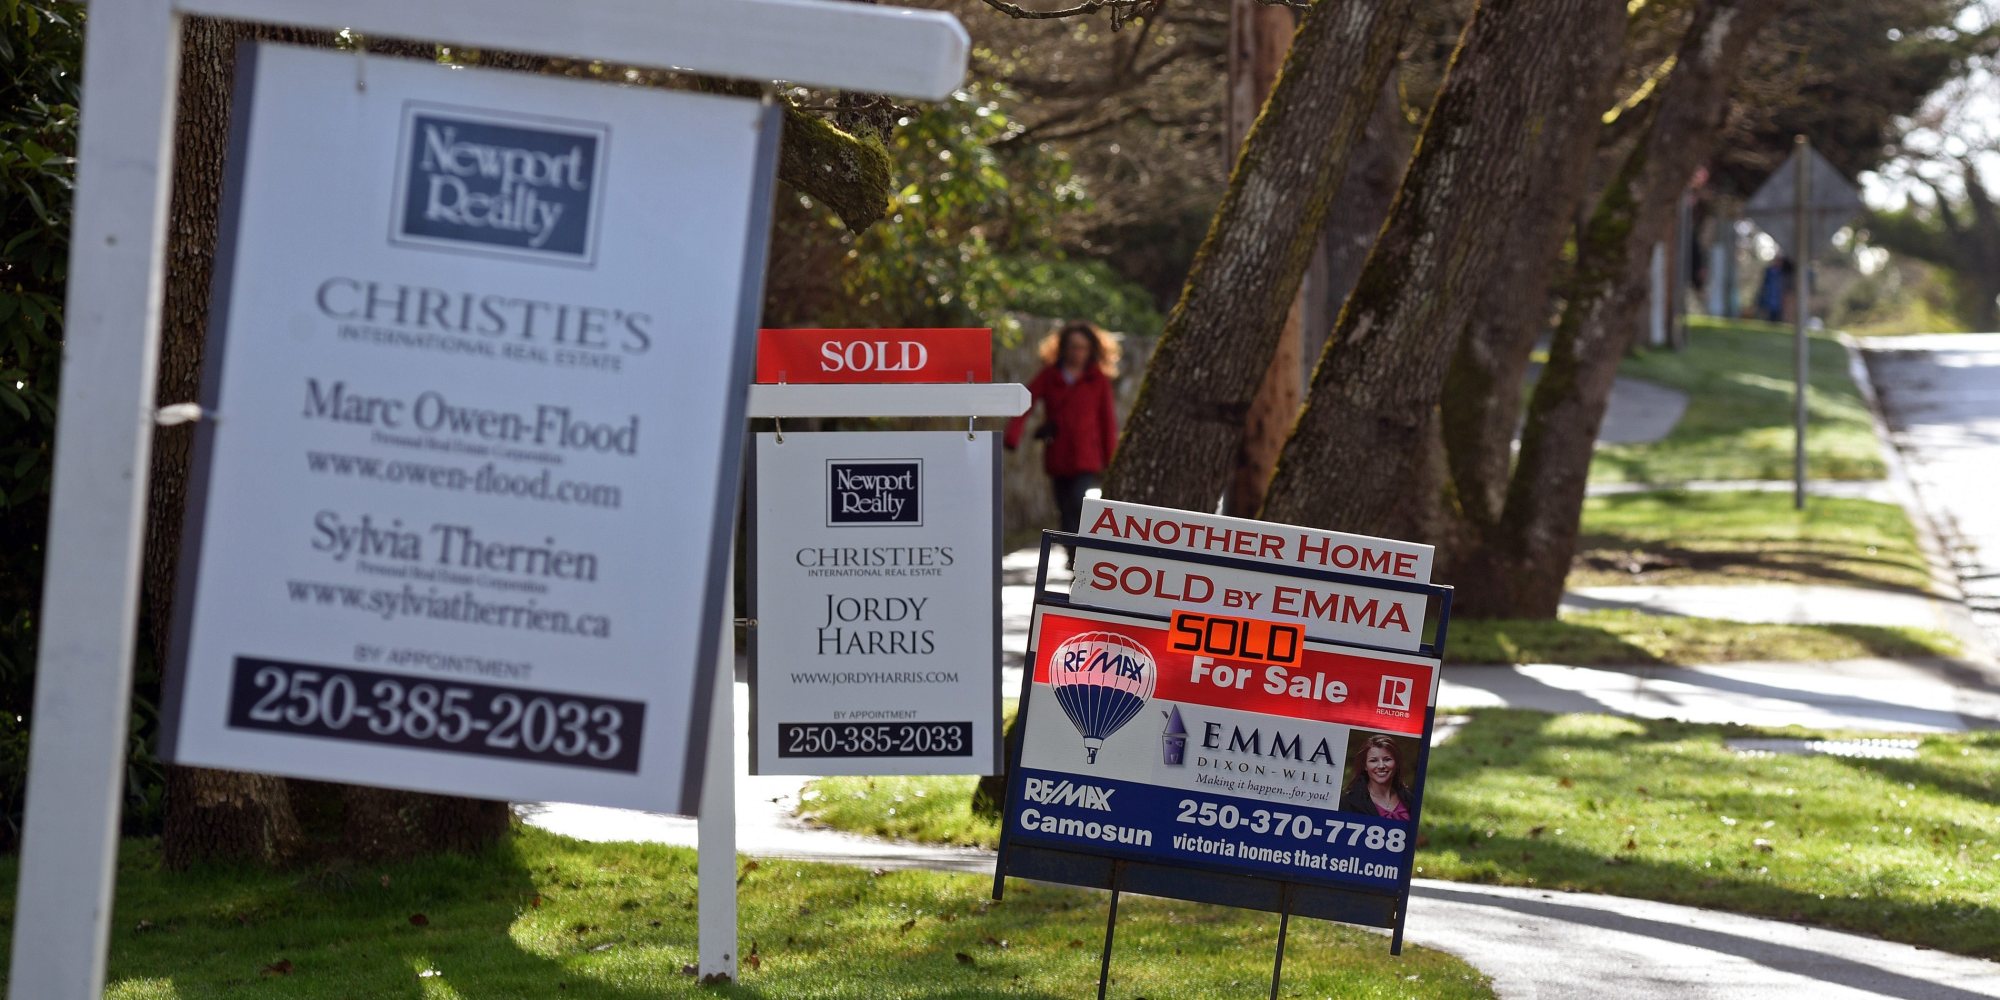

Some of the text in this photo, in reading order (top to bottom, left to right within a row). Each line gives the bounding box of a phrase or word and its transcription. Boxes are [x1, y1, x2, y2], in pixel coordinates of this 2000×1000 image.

[418, 122, 587, 194] Newport
[424, 173, 565, 248] Realty
[315, 276, 653, 356] CHRISTIE'S
[337, 324, 623, 371] INTERNATIONAL REAL ESTATE
[820, 340, 929, 372] SOLD
[302, 377, 641, 456] Marc Owen-Flood
[306, 451, 623, 508] www.owen-flood.com
[836, 468, 915, 498] Newport
[841, 490, 906, 520] Realty
[312, 509, 598, 583] Sylvia Therrien
[796, 547, 954, 567] CHRISTIE'S
[1089, 506, 1419, 579] ANOTHER HOME
[808, 568, 943, 577] INTERNATIONAL REAL ESTATE
[286, 578, 612, 639] www.sylviatherrien.ca
[825, 594, 929, 629] JORDY
[1089, 561, 1412, 634] SOLD BY EMMA
[816, 626, 935, 656] HARRIS
[1173, 613, 1299, 664] SOLD
[354, 644, 534, 680] BY APPOINTMENT
[791, 672, 959, 686] WWW.JORDYHARRIS.COM
[1063, 647, 1146, 684] RE/MAX
[1190, 656, 1349, 703] For Sale
[247, 665, 624, 761] 250-385-2033
[833, 710, 918, 720] BY APPOINTMENT
[788, 726, 963, 753] 250-385-2033
[1200, 721, 1337, 766] EMMA
[1024, 777, 1117, 812] RE/MAX
[1195, 773, 1235, 791] Making
[1237, 777, 1246, 789] it
[1307, 791, 1330, 801] you!
[1020, 808, 1153, 847] Camosun
[1176, 799, 1407, 853] 250-370-7788
[1173, 833, 1399, 880] victoria homes that sell.com
